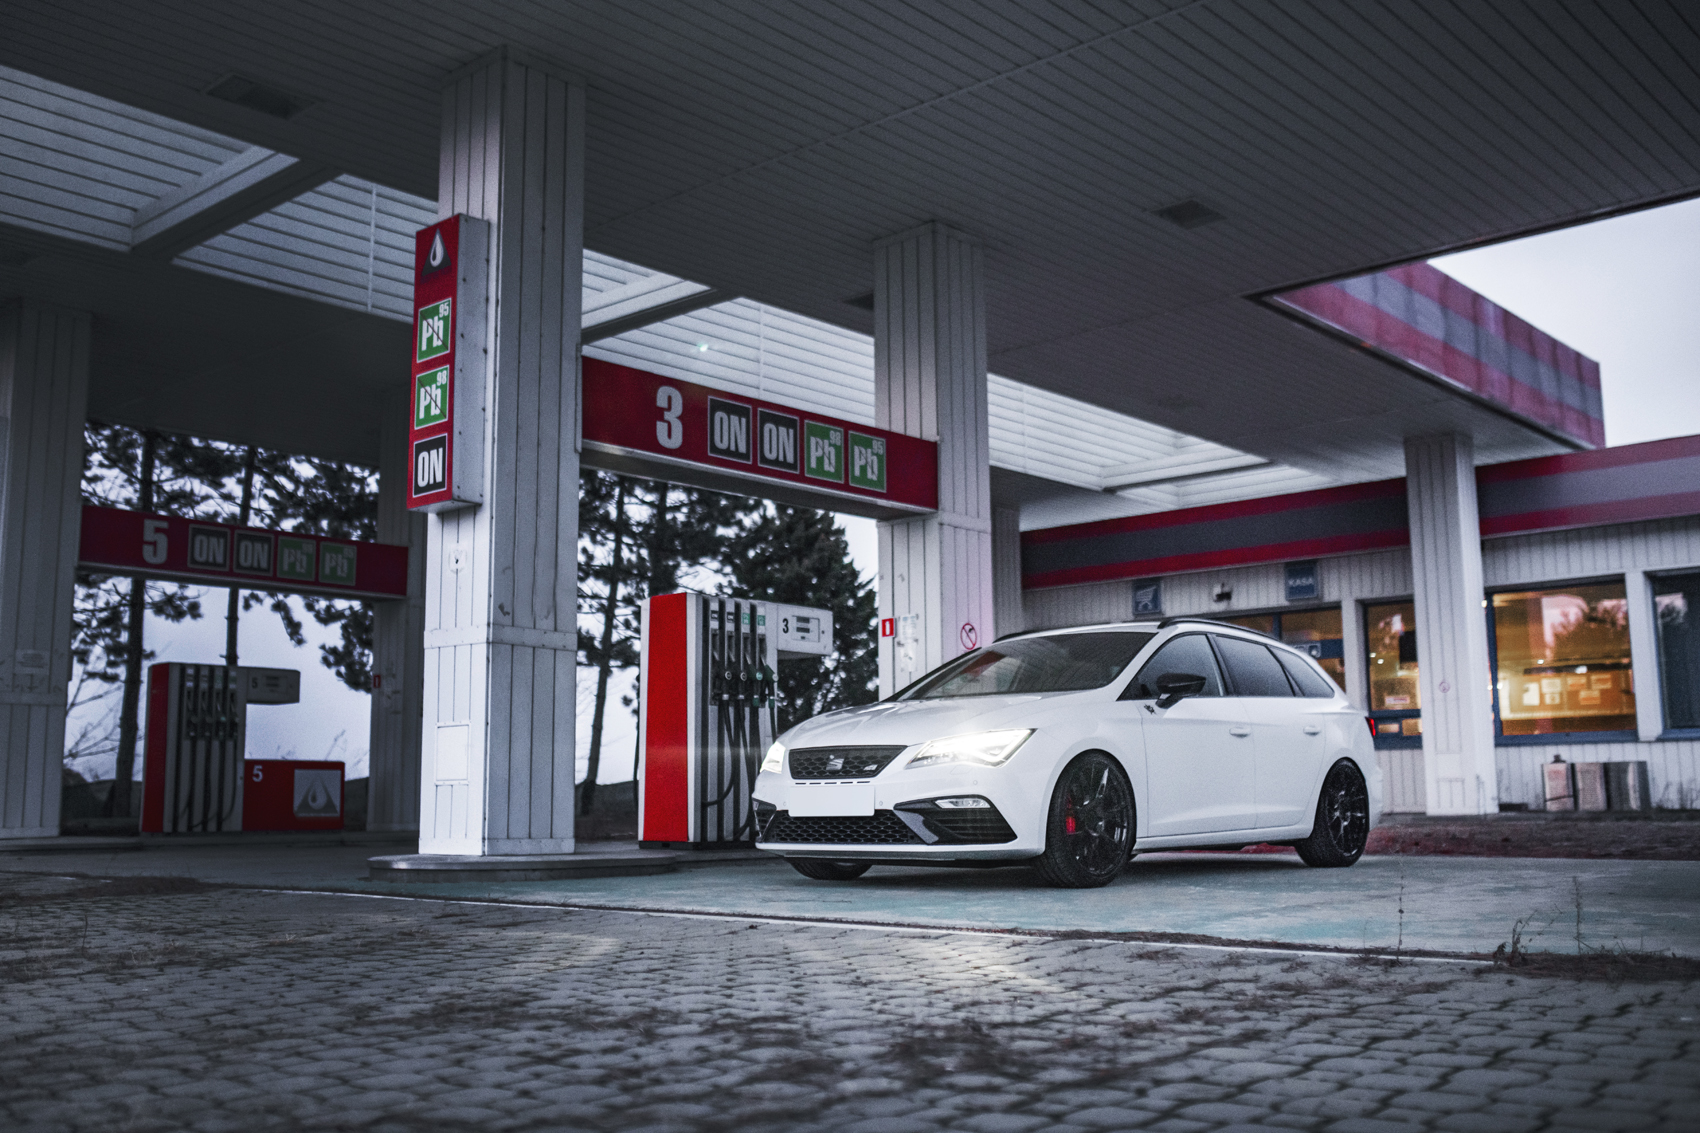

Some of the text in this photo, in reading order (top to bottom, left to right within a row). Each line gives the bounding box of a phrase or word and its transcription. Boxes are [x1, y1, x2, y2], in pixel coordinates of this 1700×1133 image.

[421, 301, 449, 352] Pb 95
[418, 370, 447, 420] Pb 98
[656, 385, 683, 450] 3
[713, 410, 747, 454] ON
[763, 422, 795, 464] ON
[809, 435, 836, 473] Pb
[853, 445, 879, 481] Pb
[416, 447, 443, 488] ON
[142, 518, 169, 565] 5
[193, 535, 225, 564] ON
[238, 540, 269, 570] ON
[282, 547, 307, 574] Pb
[324, 552, 348, 578] Pb
[782, 617, 790, 634] 3
[251, 677, 259, 690] 5
[252, 765, 263, 782] 5
